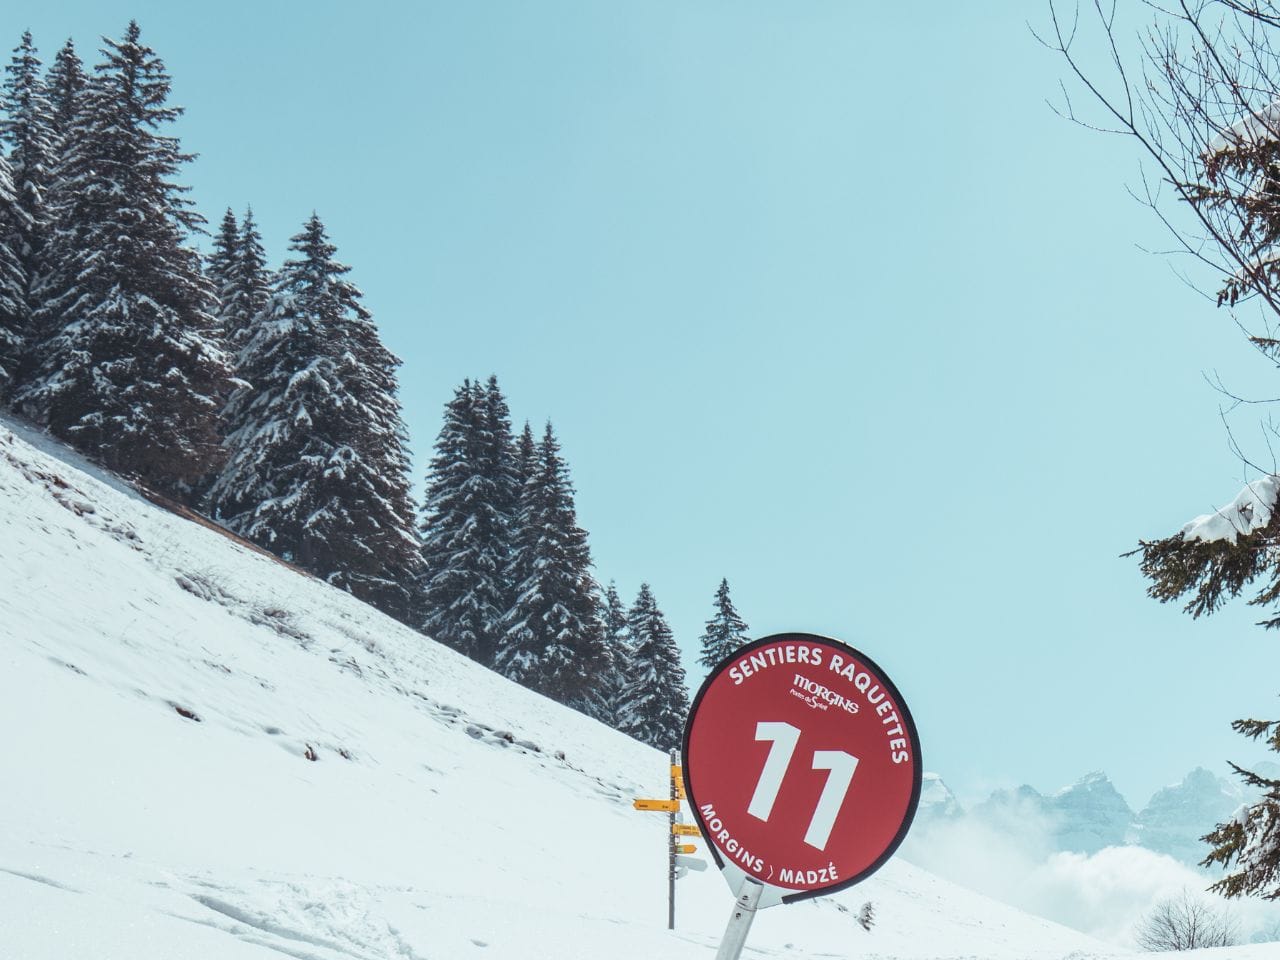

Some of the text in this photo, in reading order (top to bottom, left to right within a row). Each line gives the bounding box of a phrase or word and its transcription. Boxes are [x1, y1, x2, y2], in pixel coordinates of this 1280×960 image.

[729, 645, 909, 764] SENTIERS RAQUETTES
[793, 674, 860, 714] MORGINS
[747, 721, 860, 851] 11
[700, 803, 838, 884] MORGINS MADZÉ
